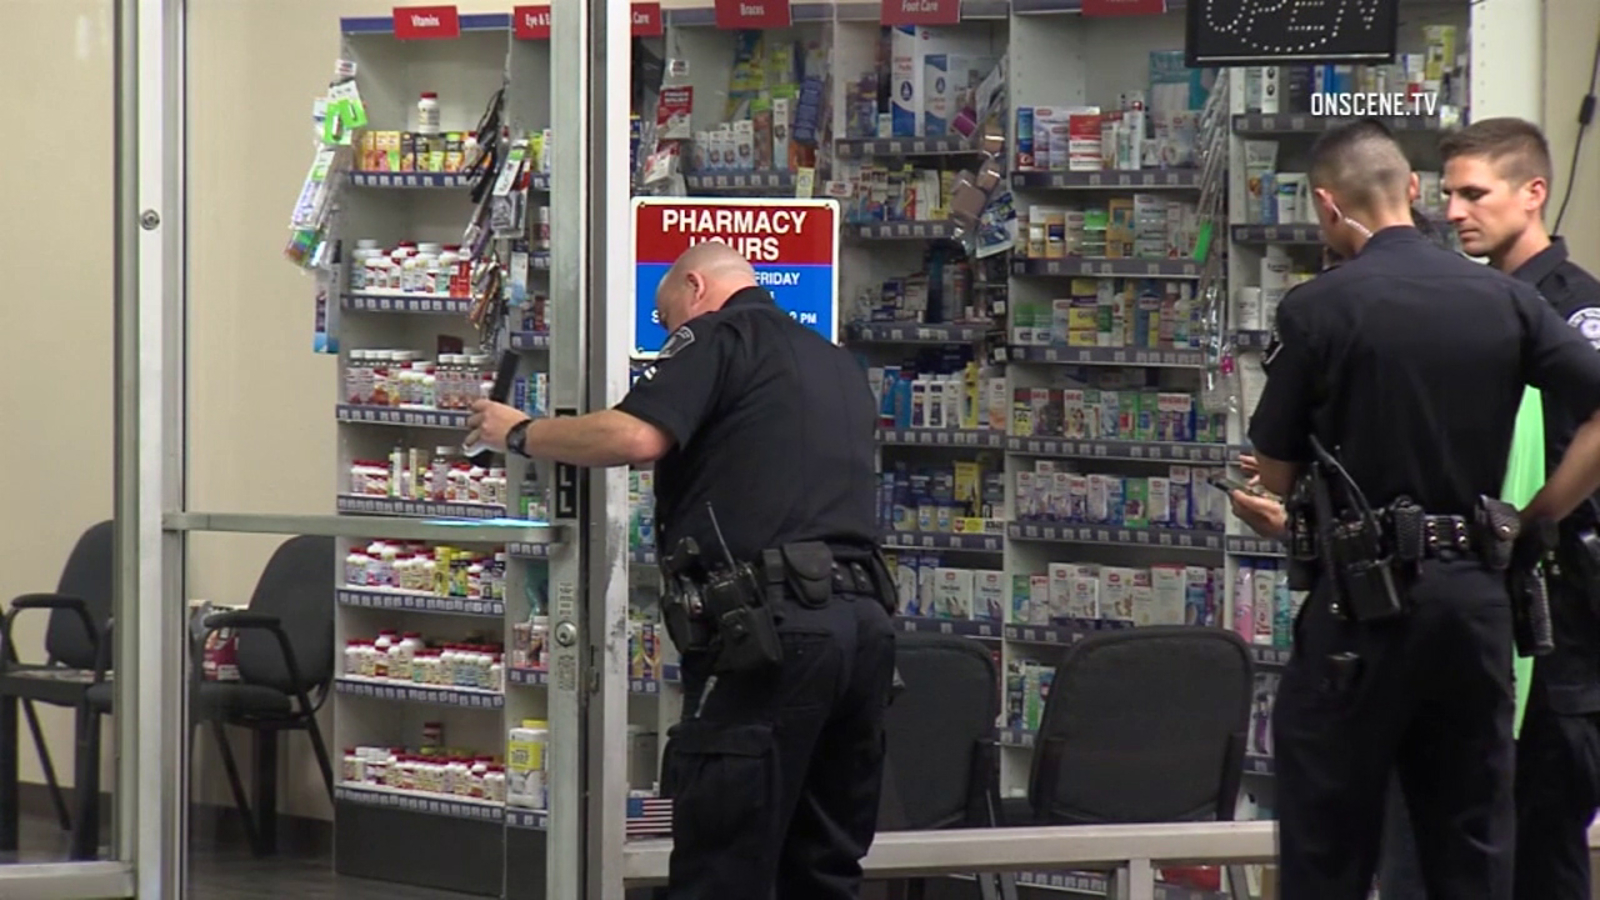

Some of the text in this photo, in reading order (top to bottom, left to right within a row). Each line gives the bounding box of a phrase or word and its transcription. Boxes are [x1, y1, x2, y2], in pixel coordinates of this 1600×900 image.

[410, 13, 440, 27] Vitamins
[525, 13, 537, 29] Eye
[633, 11, 650, 24] Care
[662, 209, 807, 234] PHARMACY
